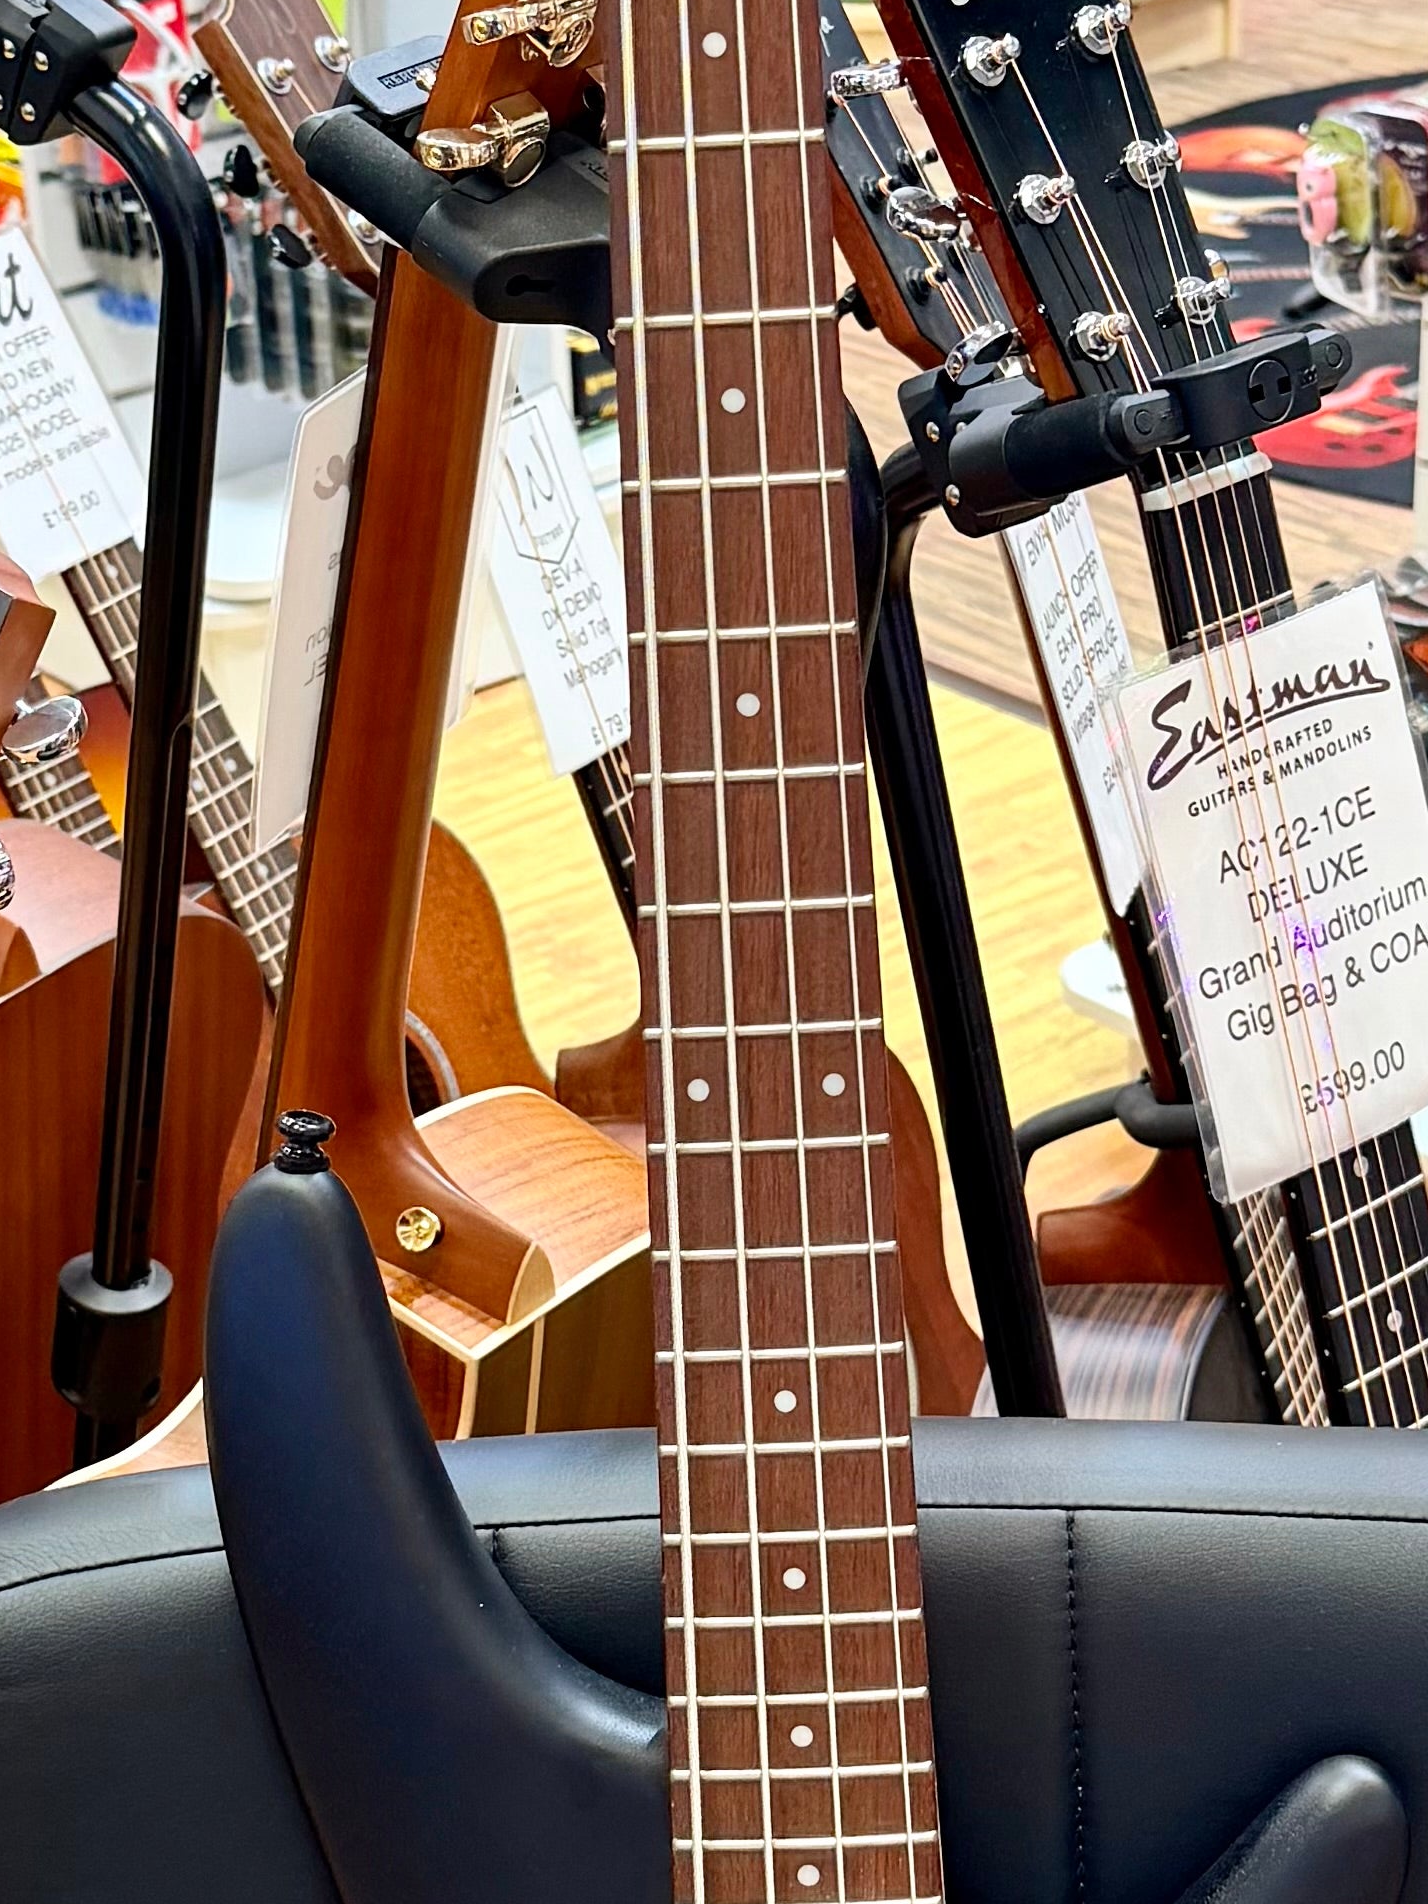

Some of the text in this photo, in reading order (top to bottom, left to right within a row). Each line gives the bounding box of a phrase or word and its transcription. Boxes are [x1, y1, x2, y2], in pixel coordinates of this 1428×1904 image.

[1, 326, 56, 358] OFFER
[20, 357, 55, 389] NEW
[25, 408, 81, 442] MODEL
[3, 452, 55, 487] models
[56, 427, 112, 462] available
[1070, 549, 1100, 598] OFFER
[555, 614, 613, 658] Slid Top
[1080, 595, 1102, 634] PRO
[1147, 657, 1391, 791] Eastman
[1216, 718, 1333, 780] HANDCRAFTED
[1188, 726, 1373, 818] GUITARS & MANDOLINS
[1248, 843, 1368, 923] DELUXE
[1199, 876, 1428, 999] Grand Auditorium
[1227, 1002, 1275, 1041] Gig
[1280, 973, 1337, 1018] Bag
[1345, 956, 1366, 988] &
[1301, 1041, 1406, 1115] £599.00
